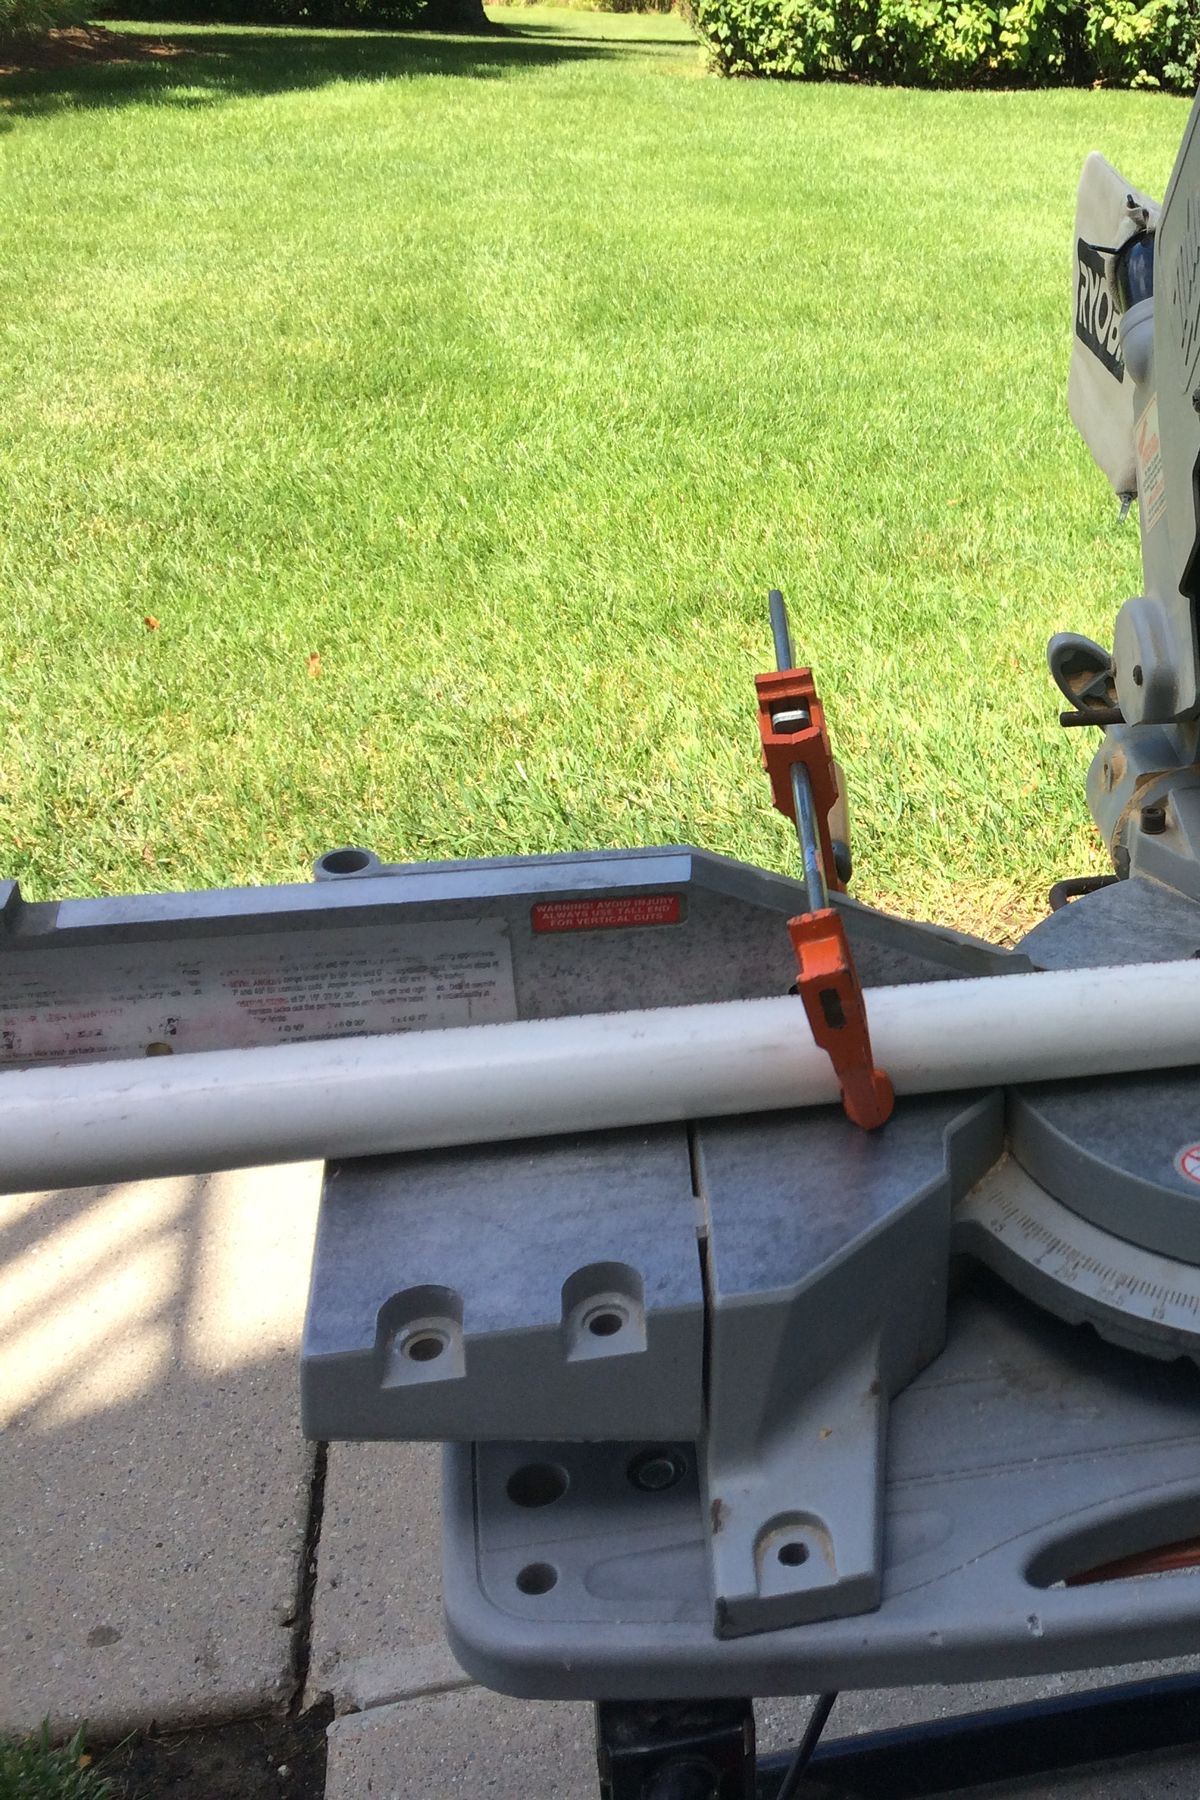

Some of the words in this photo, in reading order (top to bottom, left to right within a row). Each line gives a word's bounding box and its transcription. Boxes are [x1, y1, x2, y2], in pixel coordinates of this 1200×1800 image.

[596, 900, 631, 910] AVOID
[633, 897, 675, 907] INJURY
[541, 910, 590, 920] ALWAYS
[590, 909, 613, 917] USE
[617, 906, 645, 915] TALL
[646, 904, 670, 913] END
[549, 918, 574, 928] FOR
[576, 914, 630, 926] VERTICAL
[633, 911, 664, 922] CUTS
